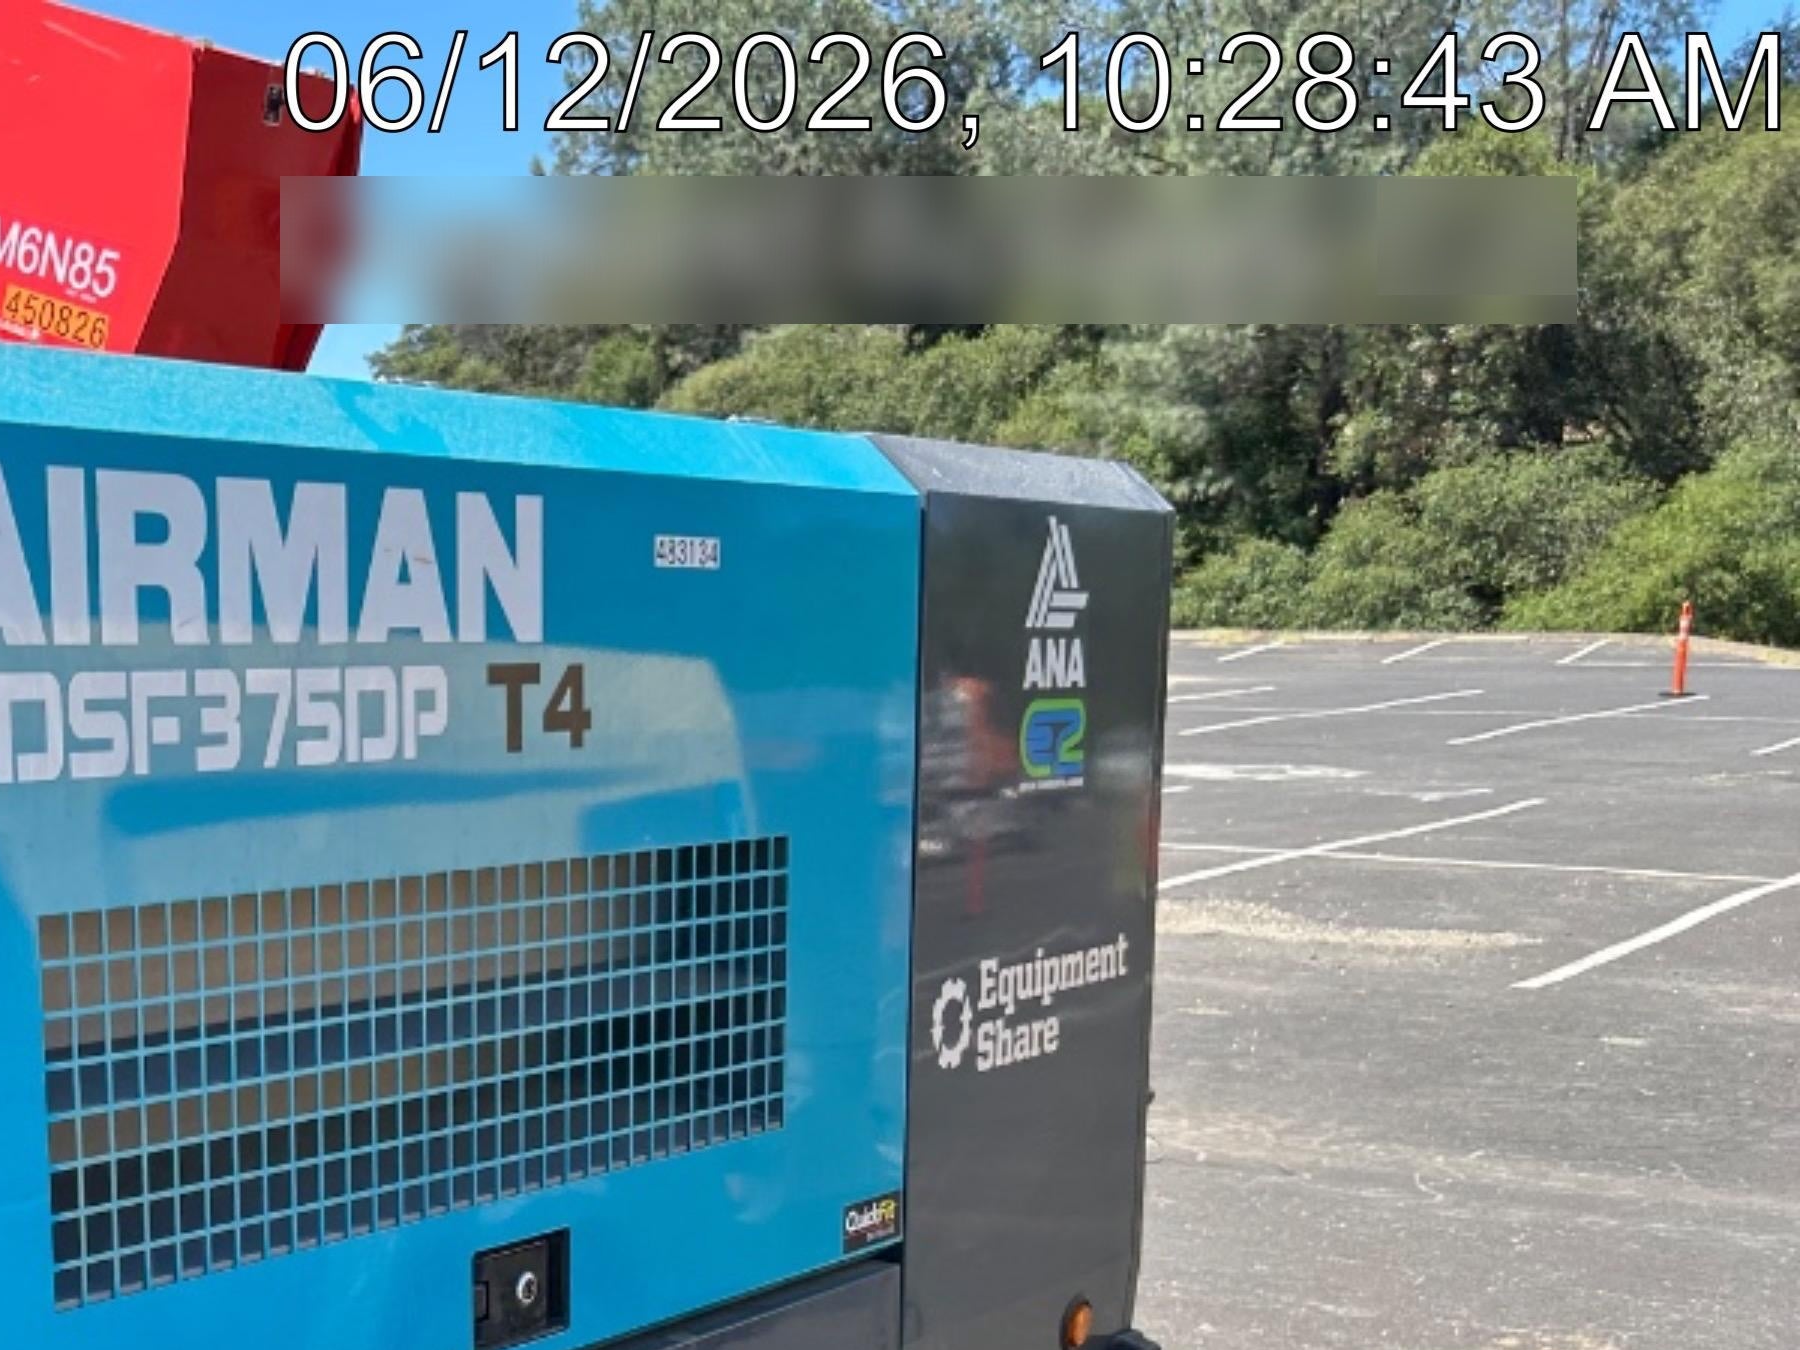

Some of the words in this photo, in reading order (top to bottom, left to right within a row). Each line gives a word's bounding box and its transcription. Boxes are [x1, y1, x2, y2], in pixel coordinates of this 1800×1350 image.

[5, 289, 107, 349] 450826
[1022, 637, 1087, 690] ANA
[486, 662, 592, 754] T4
[977, 932, 1129, 1016] Equipment
[976, 1015, 1060, 1073] Share
